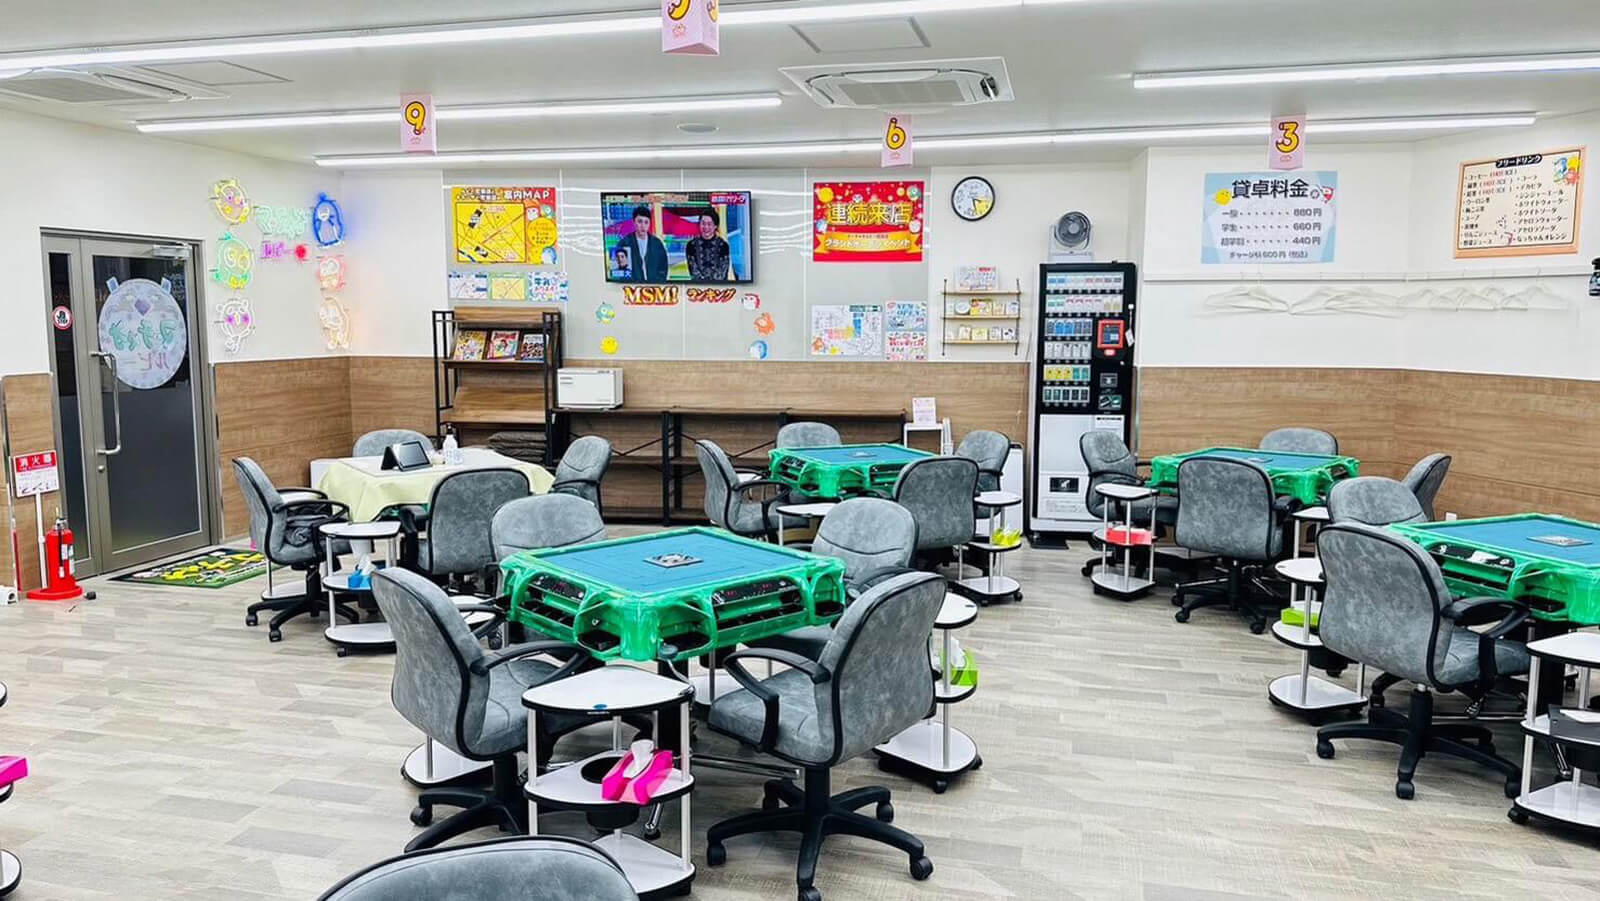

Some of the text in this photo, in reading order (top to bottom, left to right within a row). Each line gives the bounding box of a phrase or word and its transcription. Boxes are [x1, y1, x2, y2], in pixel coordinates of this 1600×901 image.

[405, 101, 425, 135] 9
[886, 117, 906, 150] 6
[1276, 121, 1299, 153] 3
[1497, 154, 1541, 167] フリードリンク
[1231, 179, 1309, 199] 貸卓料金
[827, 202, 913, 225] 連続来店
[1292, 236, 1320, 246] 440円
[623, 285, 678, 305] MSM!
[686, 287, 736, 302] ランキング
[19, 453, 52, 468] 消火器
